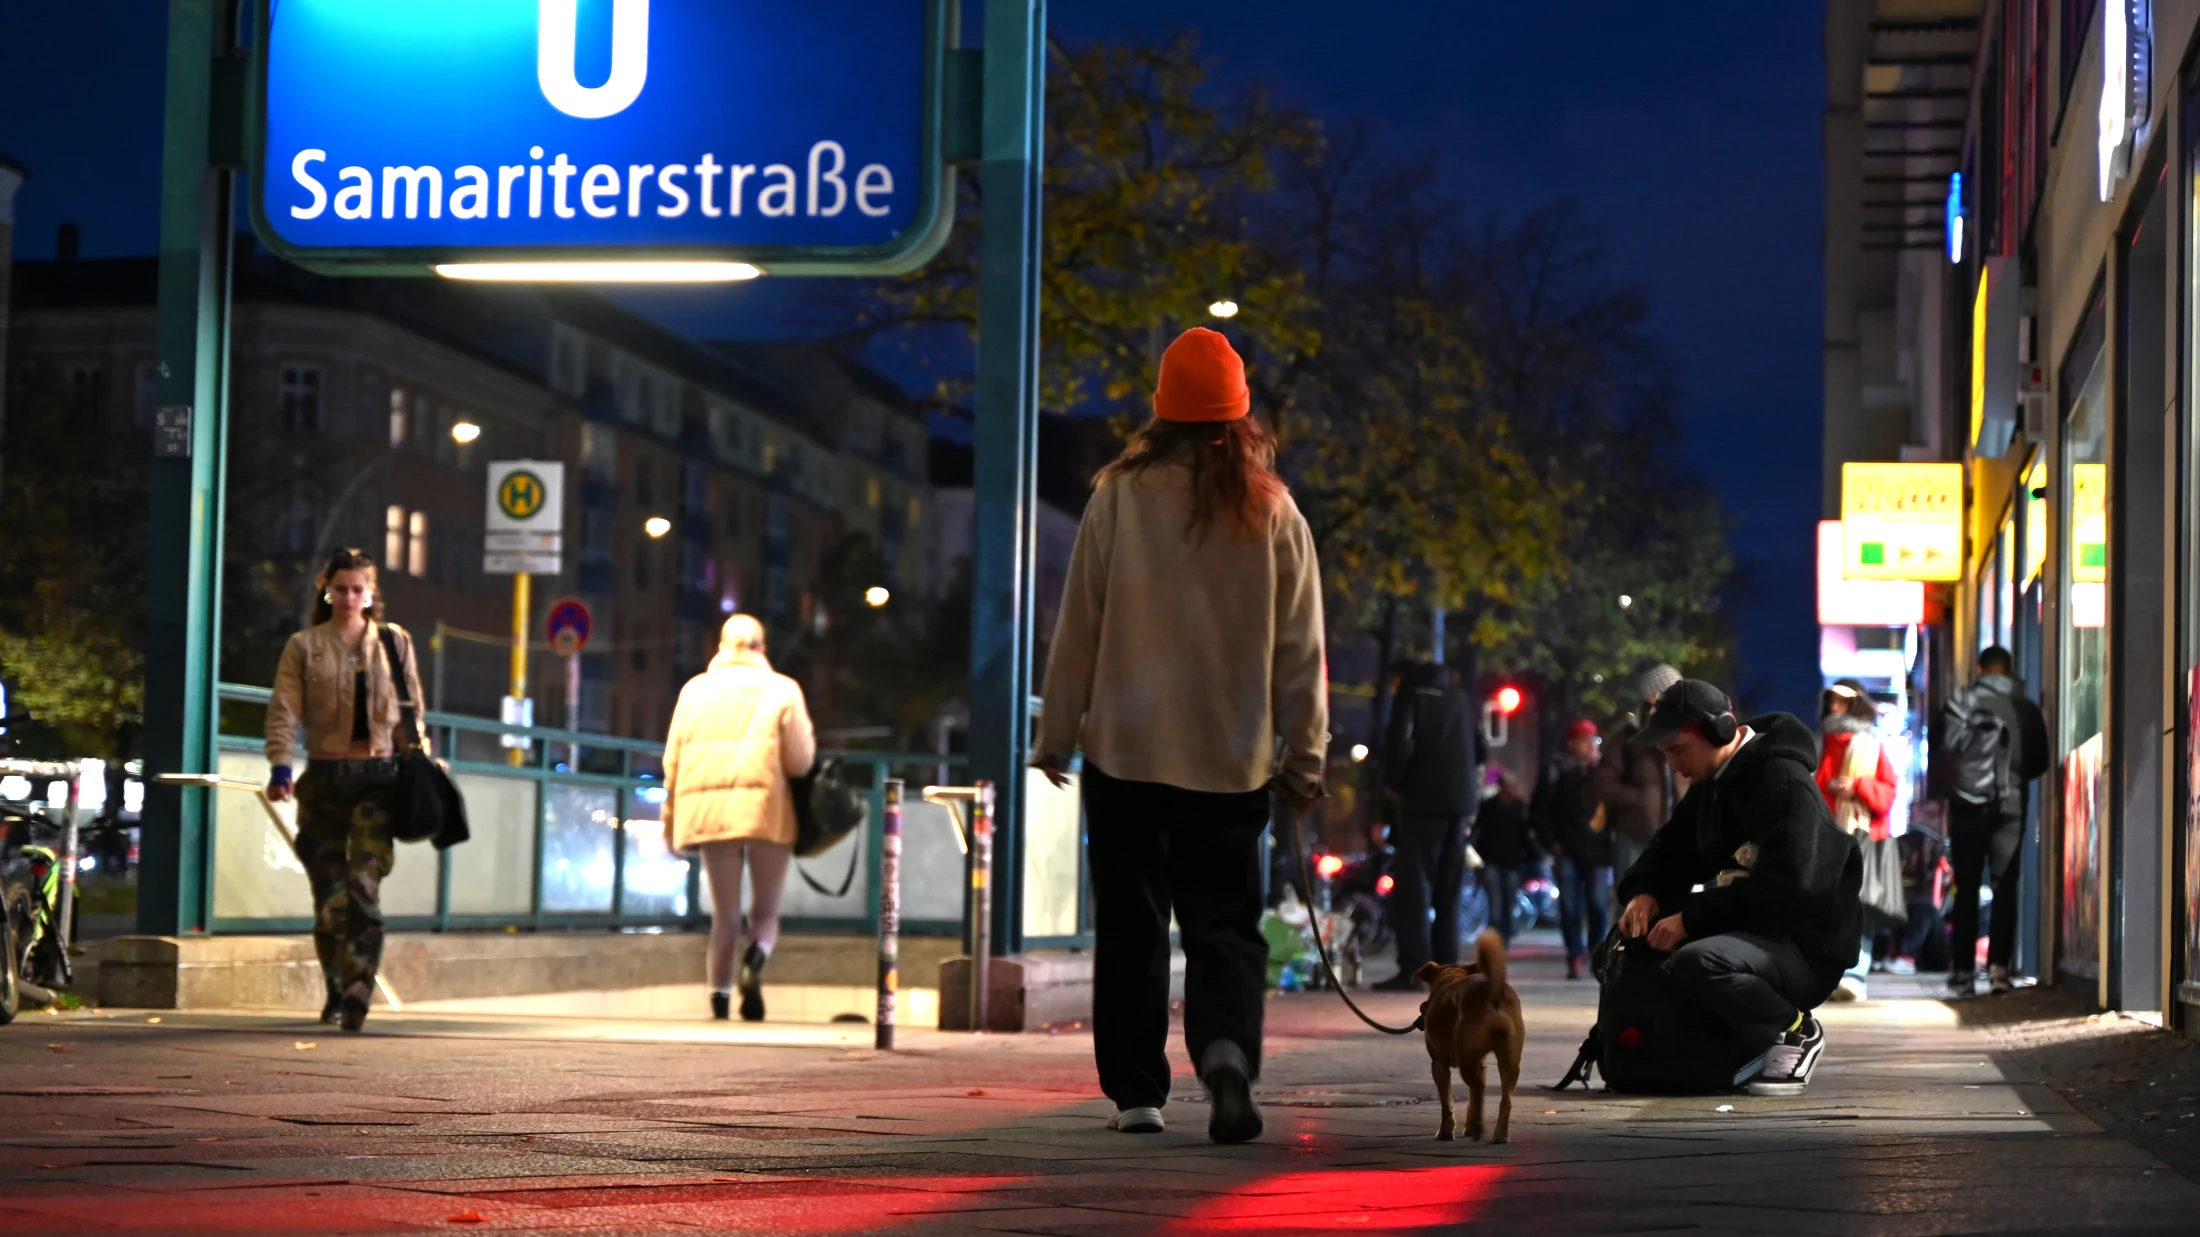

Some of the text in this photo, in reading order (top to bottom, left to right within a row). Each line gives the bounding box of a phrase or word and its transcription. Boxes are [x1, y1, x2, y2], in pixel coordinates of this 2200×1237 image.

[537, 0, 650, 119] U
[290, 139, 894, 220] Samariterstraße
[510, 482, 532, 508] H
